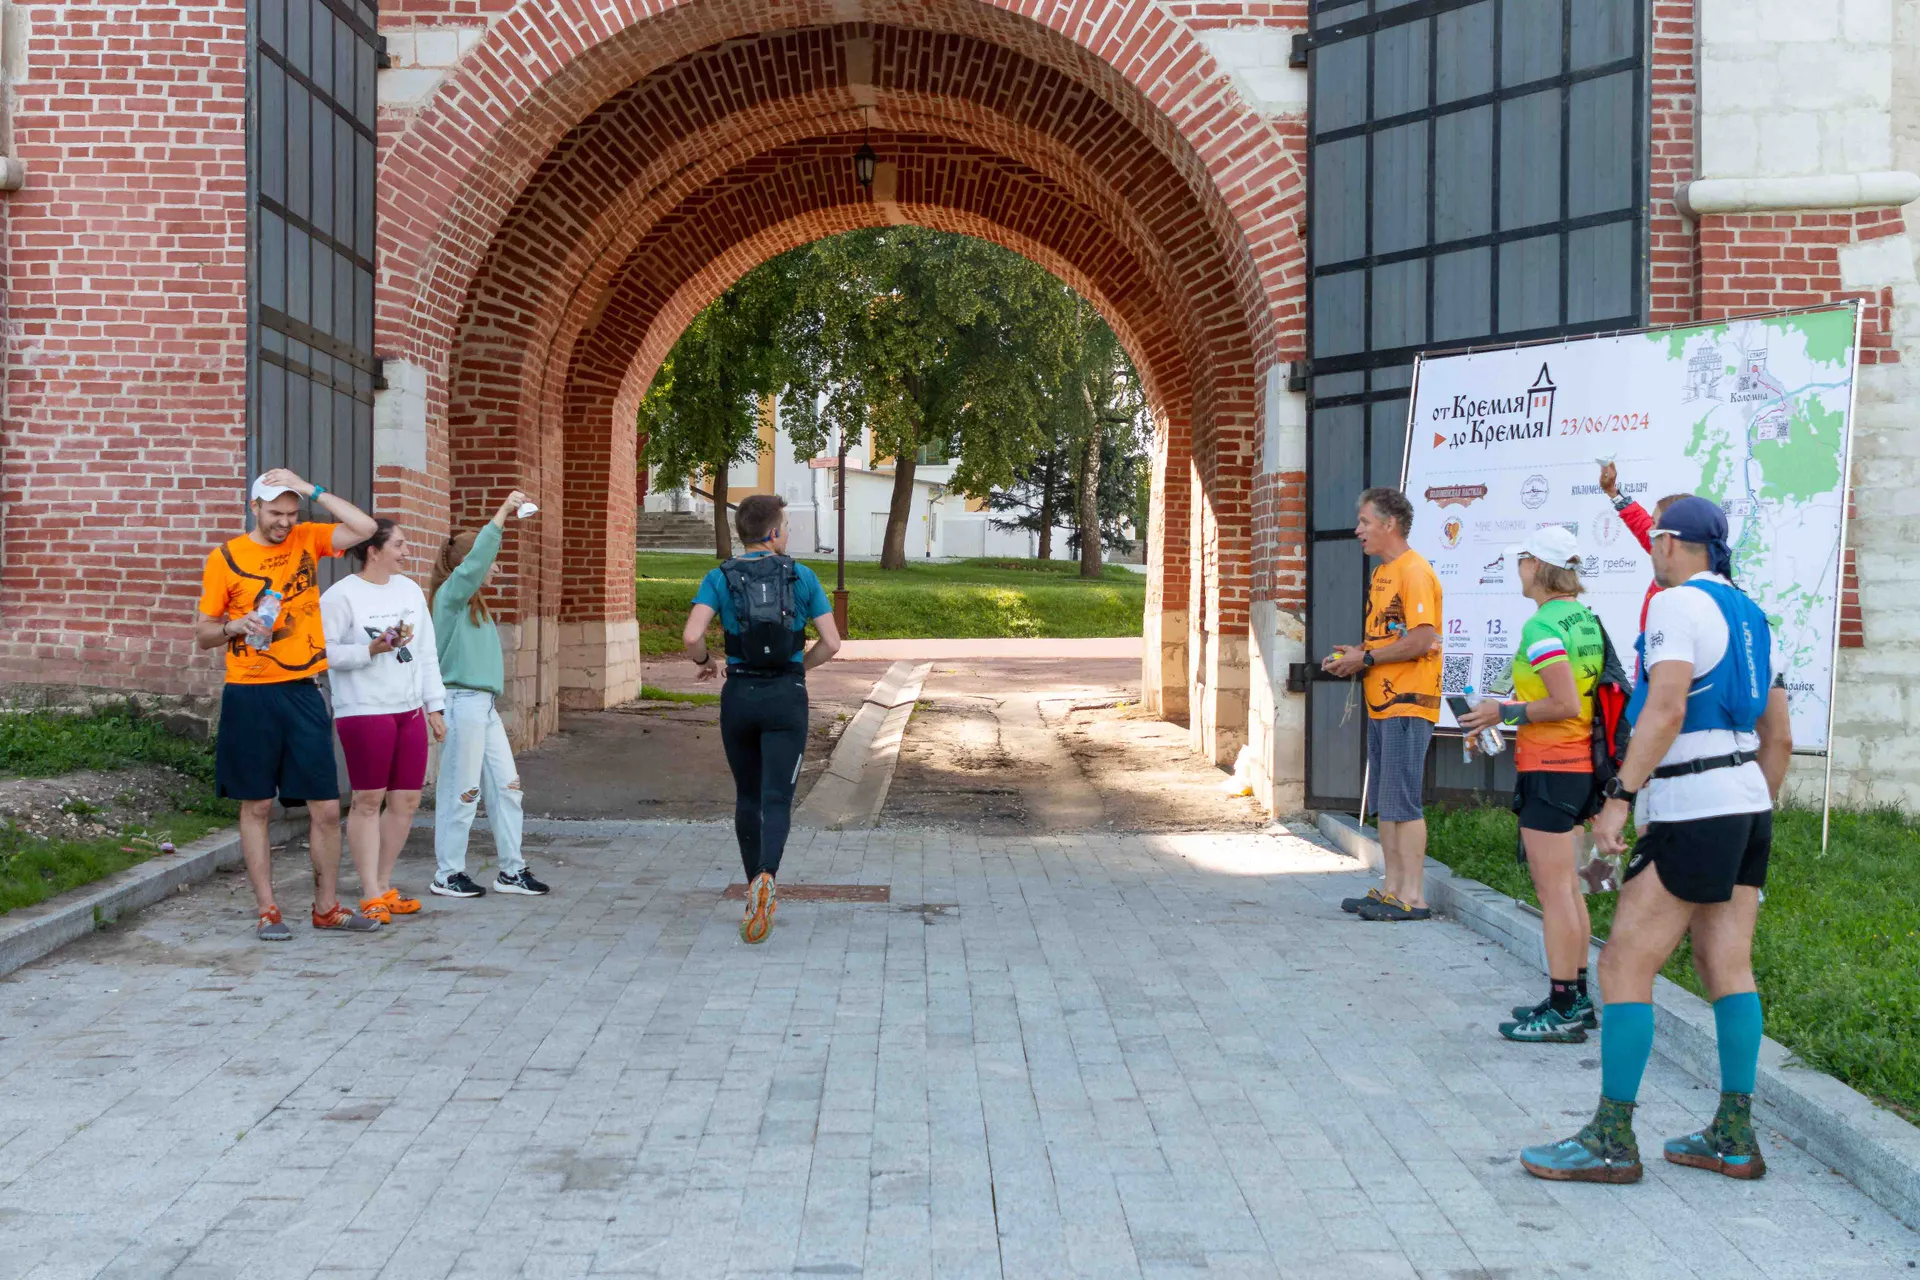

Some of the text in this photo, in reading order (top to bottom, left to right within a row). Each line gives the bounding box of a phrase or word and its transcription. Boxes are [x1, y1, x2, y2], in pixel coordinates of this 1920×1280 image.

[1730, 393, 1768, 403] Коломна
[1432, 394, 1525, 424] от Кремля
[1560, 412, 1650, 436] 23/06/2024
[1449, 419, 1544, 449] до Кремля
[1603, 557, 1637, 570] гребни
[1448, 618, 1462, 634] 12
[1487, 618, 1502, 634] 13
[1558, 612, 1584, 632] Dream
[1784, 681, 1815, 691] арайск
